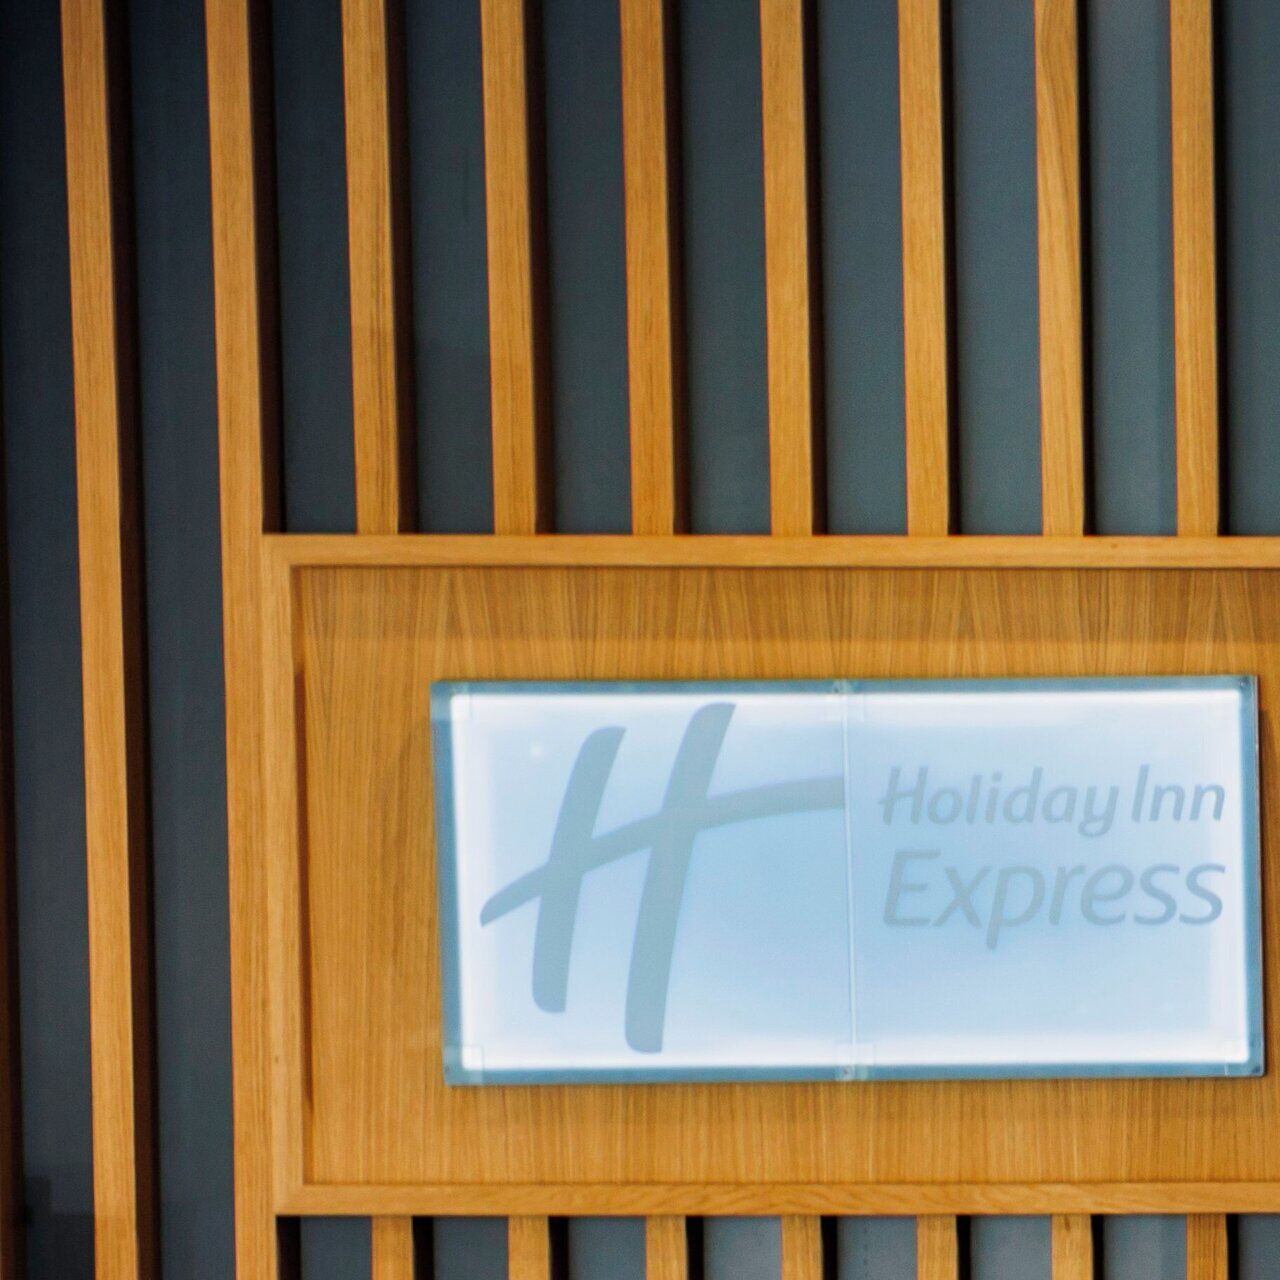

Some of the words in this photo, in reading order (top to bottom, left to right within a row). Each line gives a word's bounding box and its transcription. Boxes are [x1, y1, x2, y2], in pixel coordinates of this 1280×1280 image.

[878, 766, 1120, 838] Holiday
[1131, 763, 1226, 822] Inn
[882, 849, 1227, 951] Express
